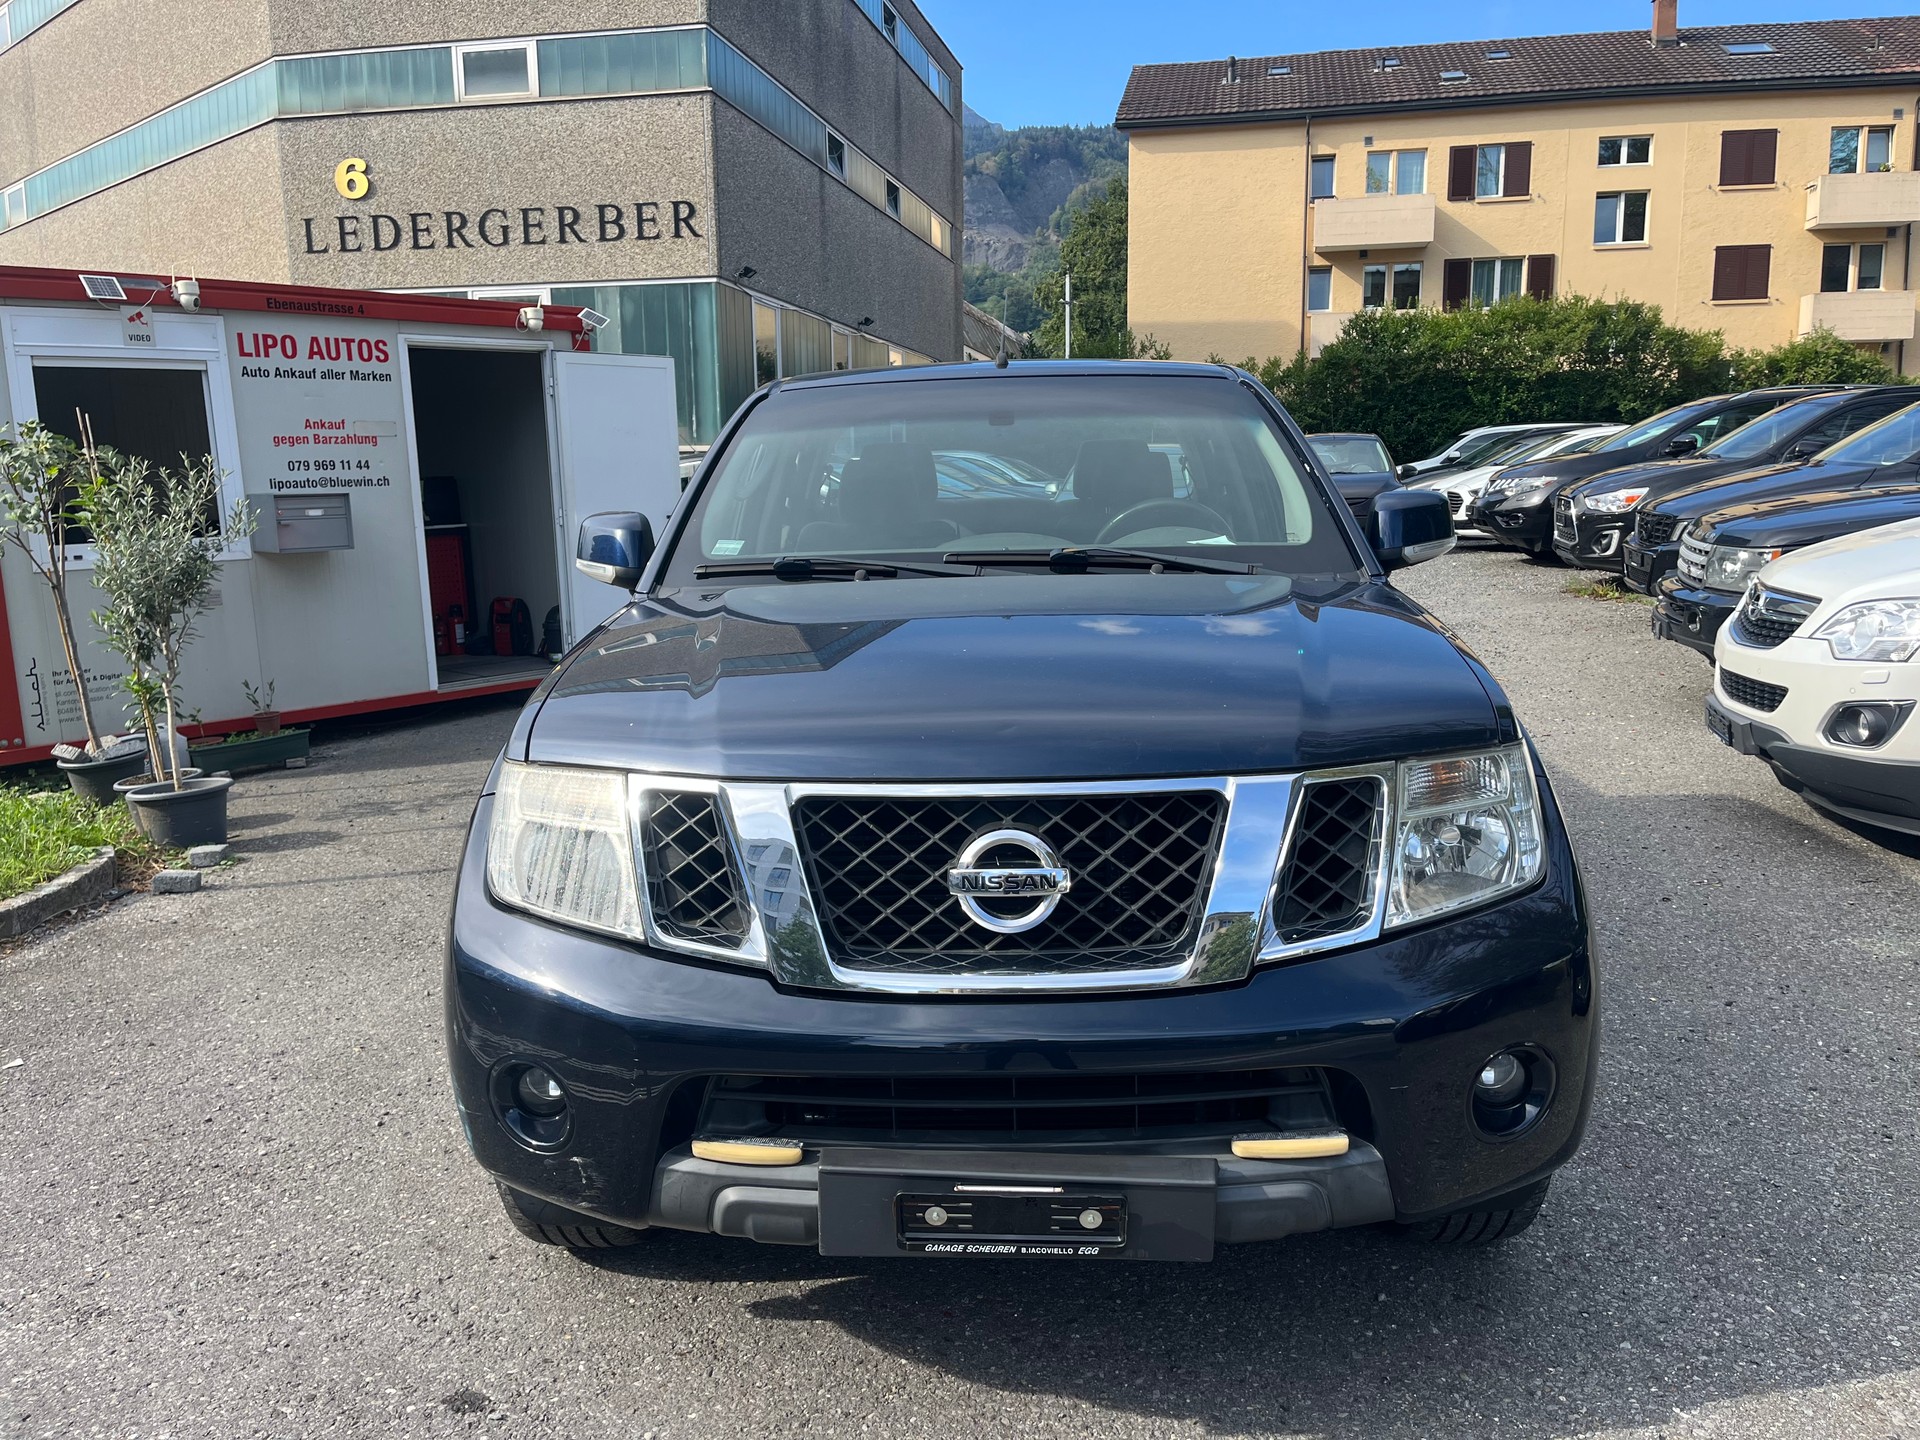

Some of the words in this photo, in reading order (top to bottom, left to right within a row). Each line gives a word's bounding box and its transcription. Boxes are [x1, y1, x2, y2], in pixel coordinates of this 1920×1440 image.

[335, 158, 369, 199] 6
[303, 201, 702, 253] LEDERGERBER
[266, 298, 354, 314] Ebenaustrasse
[357, 304, 364, 314] 4
[128, 334, 151, 342] VIDEO
[236, 332, 298, 359] LIPO
[308, 336, 390, 363] AUTOS
[241, 366, 270, 378] Auto
[274, 367, 316, 379] Ankauf
[320, 369, 346, 380] aller
[350, 370, 392, 382] Marken
[304, 419, 346, 430] Ankauf
[273, 436, 309, 447] gegen
[313, 434, 378, 447] Barzahlung
[287, 460, 310, 471] 079
[314, 460, 336, 471] 969
[340, 460, 351, 470] 11
[356, 460, 370, 470] 44
[269, 476, 390, 491] lipoauto@bluewin.ch
[100, 672, 122, 681] Digital
[961, 873, 1056, 890] NISSAN
[966, 1245, 1017, 1253] SCHEUREN
